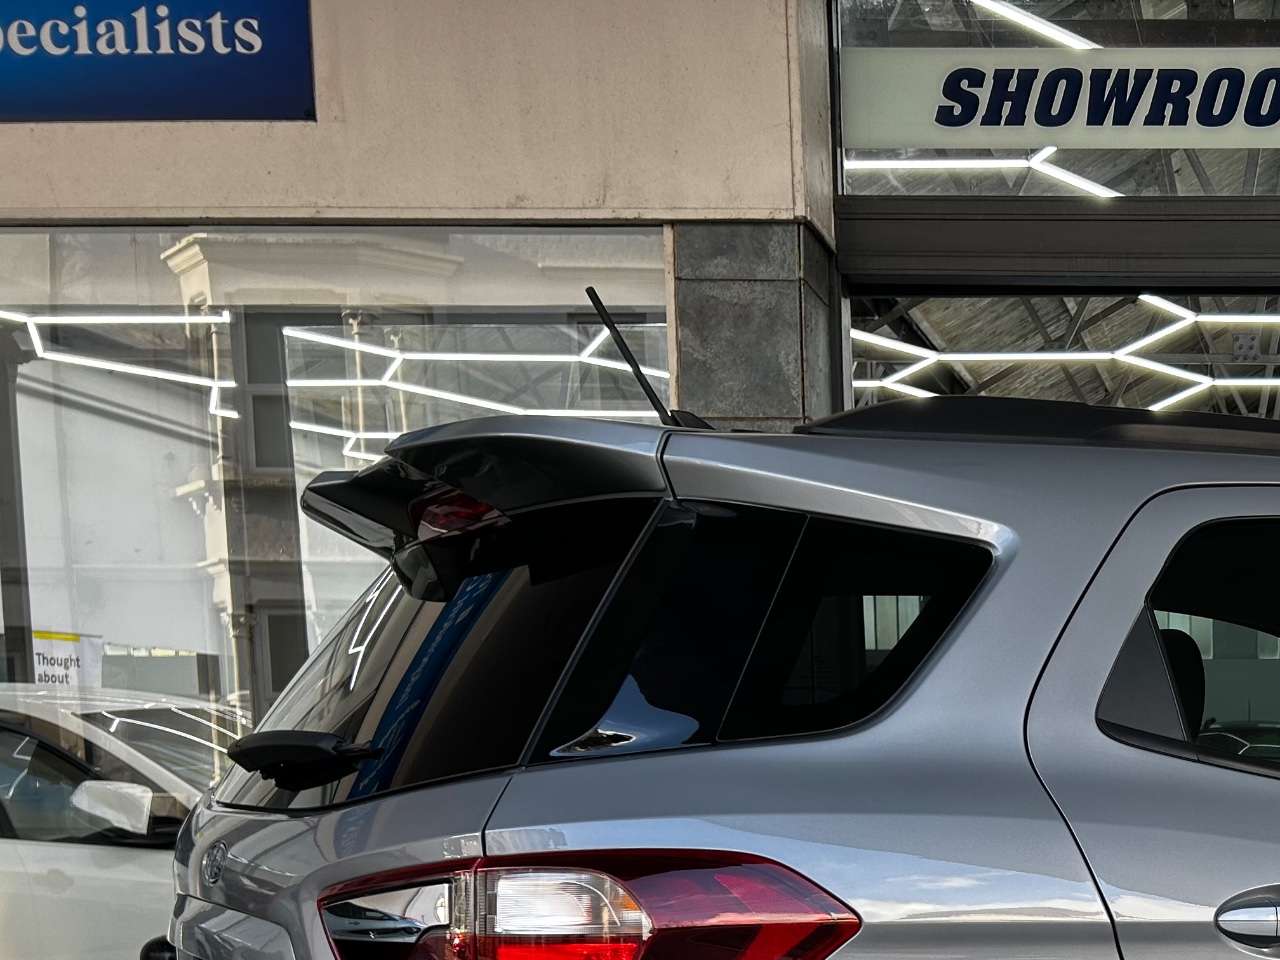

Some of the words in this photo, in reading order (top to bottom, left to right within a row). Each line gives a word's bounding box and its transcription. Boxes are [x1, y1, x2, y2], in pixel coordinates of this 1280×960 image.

[0, 5, 263, 56] ecialists
[35, 652, 80, 670] Thought
[37, 672, 70, 684] about
